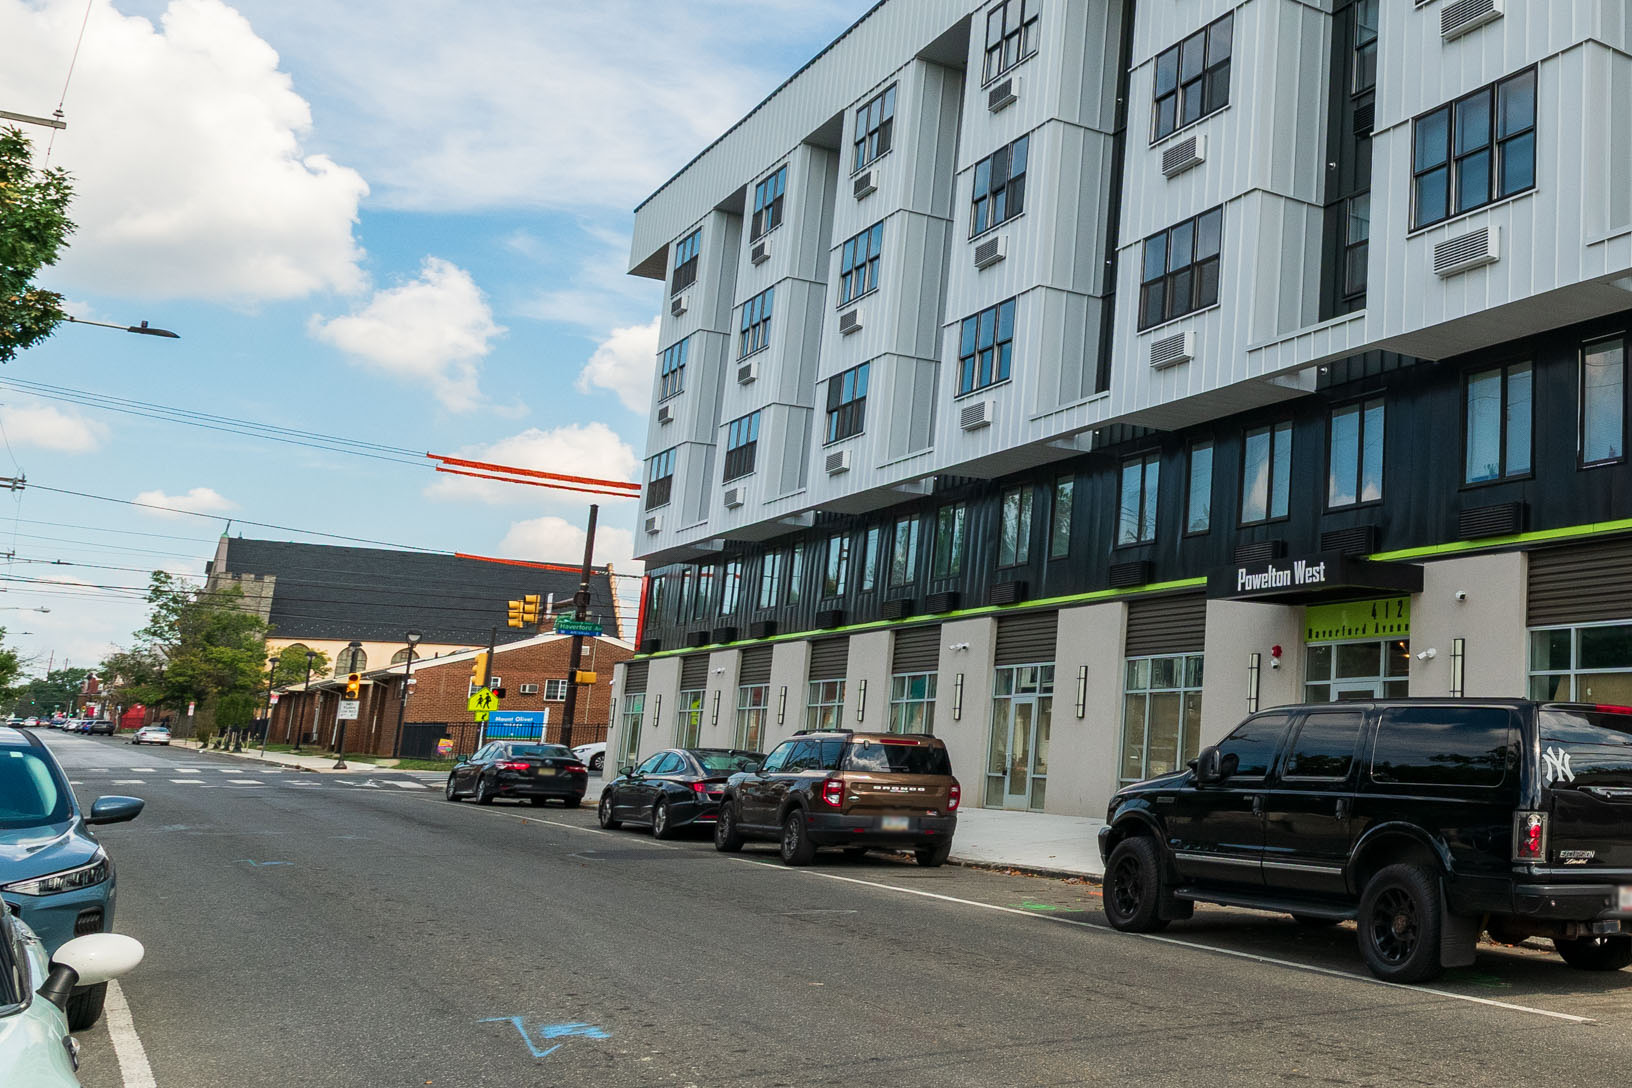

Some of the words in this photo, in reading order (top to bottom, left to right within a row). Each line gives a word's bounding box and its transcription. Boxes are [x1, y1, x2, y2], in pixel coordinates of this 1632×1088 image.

[1237, 564, 1291, 592] Powelton
[1293, 559, 1326, 585] West
[559, 623, 593, 631] Haverford
[1308, 623, 1367, 639] Haverford
[1374, 622, 1409, 634] Avenu
